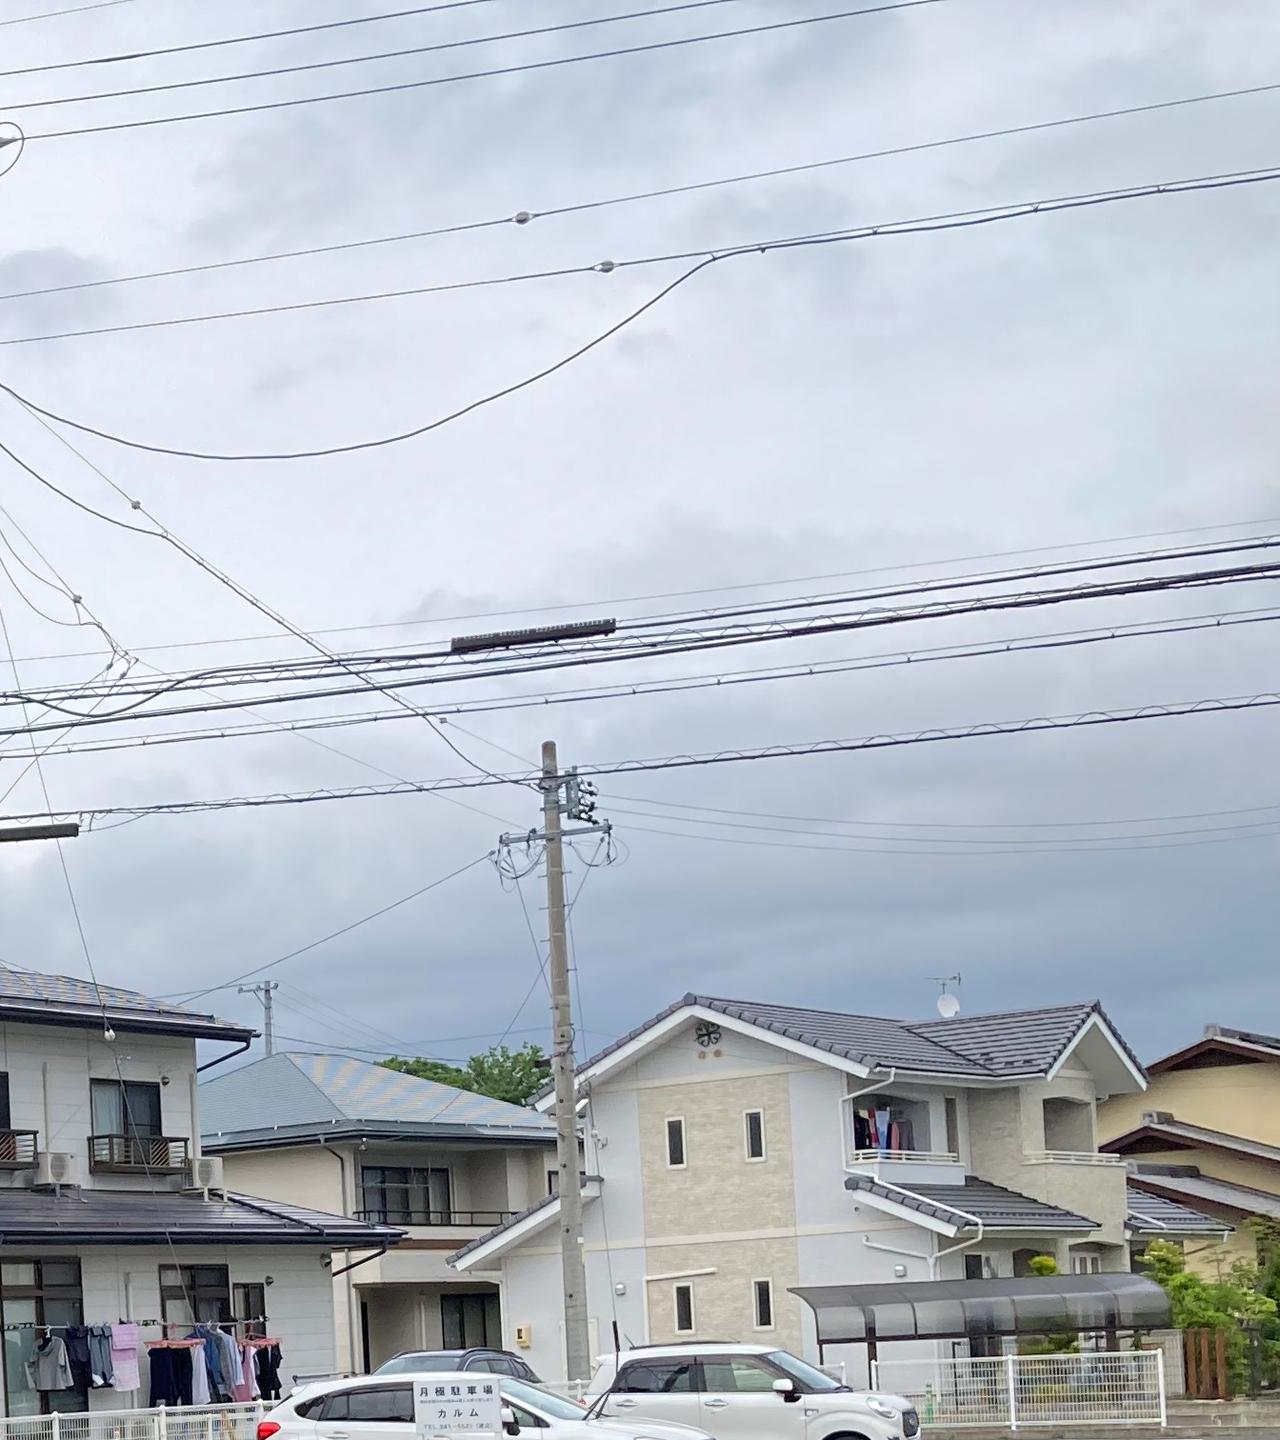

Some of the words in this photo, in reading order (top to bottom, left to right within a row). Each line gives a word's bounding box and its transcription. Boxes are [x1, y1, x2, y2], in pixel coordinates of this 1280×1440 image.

[419, 1384, 494, 1397] 月極駐車場
[437, 1407, 479, 1419] カルム
